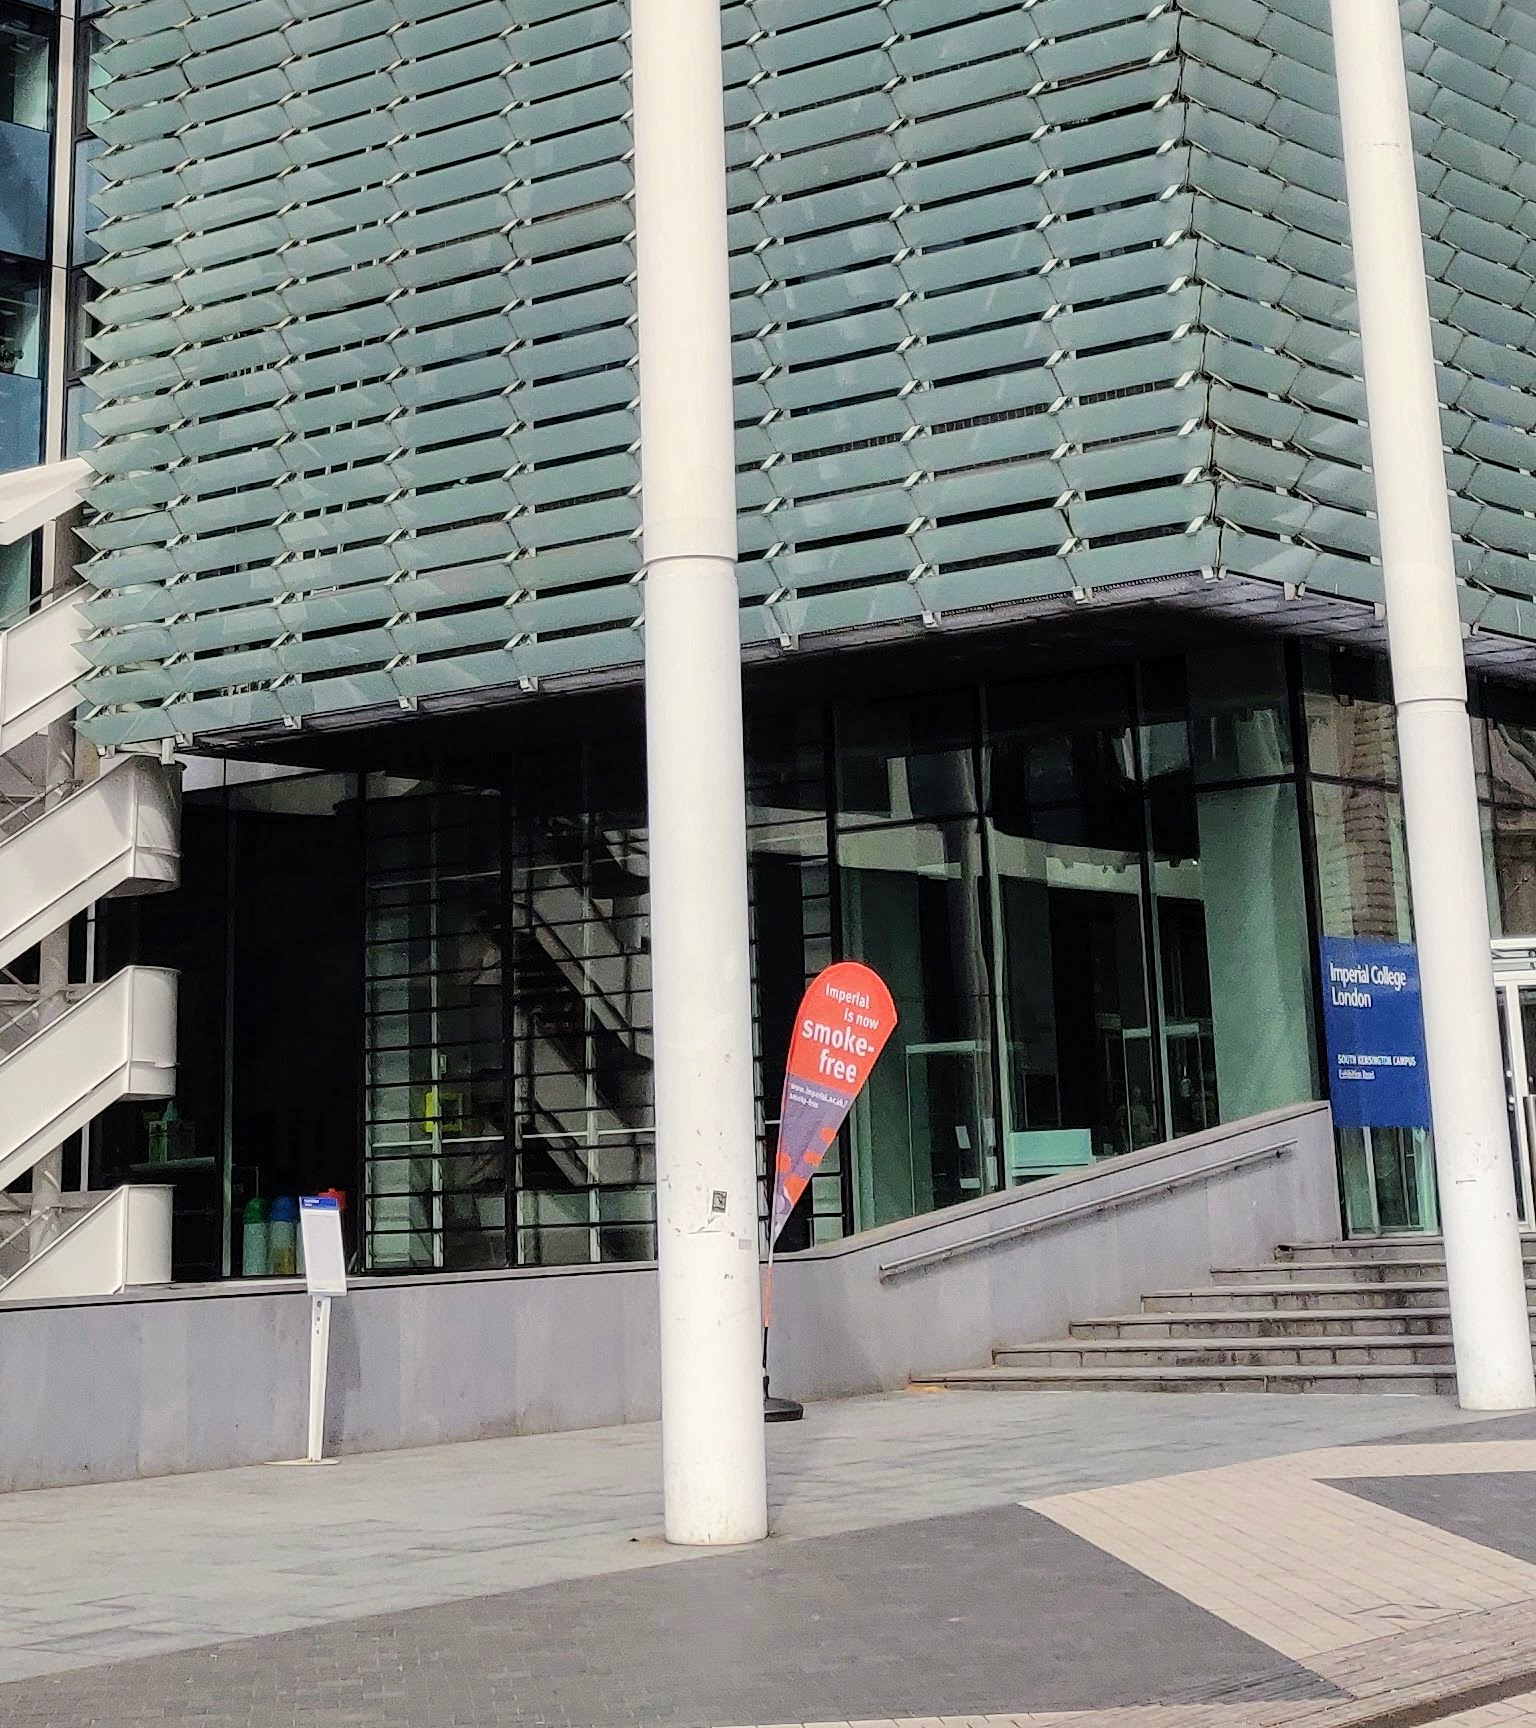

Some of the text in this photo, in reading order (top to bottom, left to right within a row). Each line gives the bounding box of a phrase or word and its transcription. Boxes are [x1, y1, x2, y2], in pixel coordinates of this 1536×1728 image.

[1330, 962, 1407, 991] Imperial College
[825, 983, 870, 1009] Imperial
[1331, 986, 1372, 1007] London
[844, 1007, 880, 1030] is now
[801, 1019, 875, 1057] smoke-
[818, 1048, 858, 1084] free
[1337, 1053, 1357, 1065] SOUTH
[1393, 1055, 1417, 1067] CAMPUS
